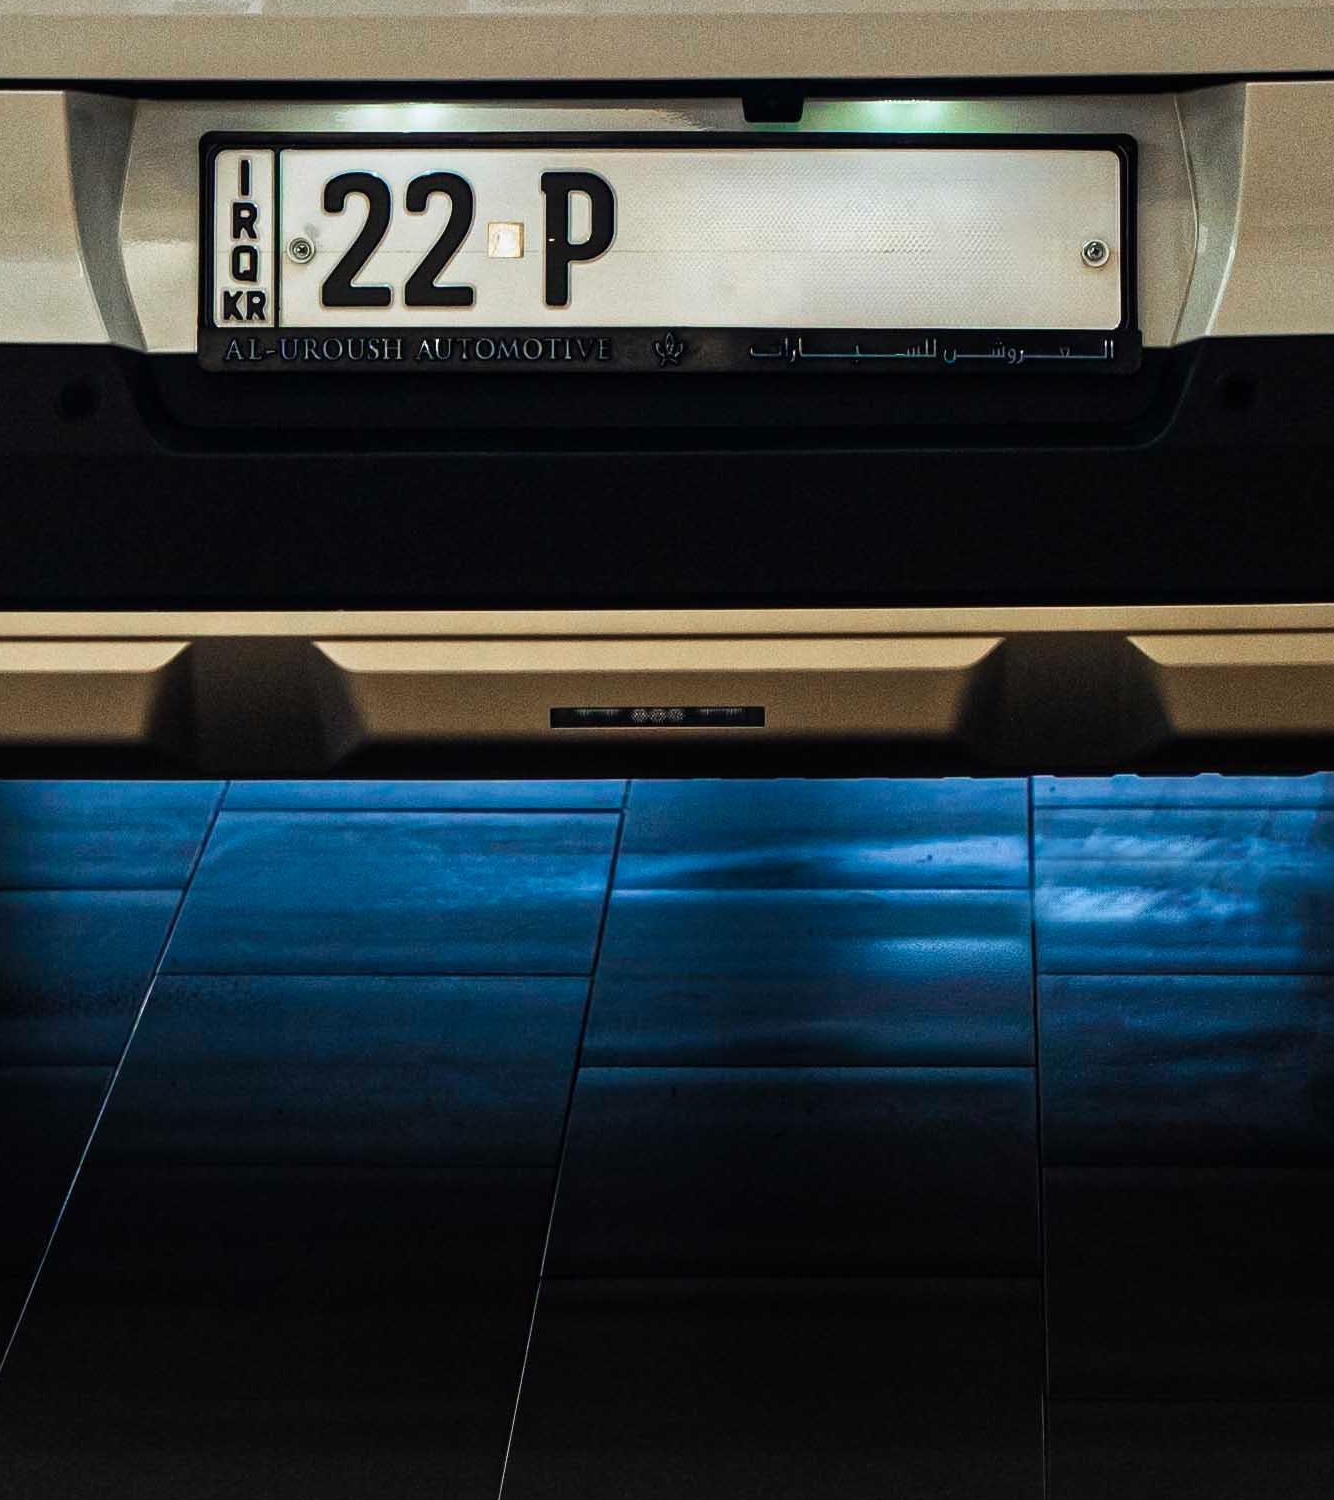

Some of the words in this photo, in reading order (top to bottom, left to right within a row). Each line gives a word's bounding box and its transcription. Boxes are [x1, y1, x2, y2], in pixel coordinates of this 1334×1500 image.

[321, 171, 475, 307] 22
[540, 171, 616, 307] P
[222, 290, 267, 321] KR
[224, 337, 404, 362] AL-UROUSH
[415, 337, 612, 362] AUTOMOTIVE
